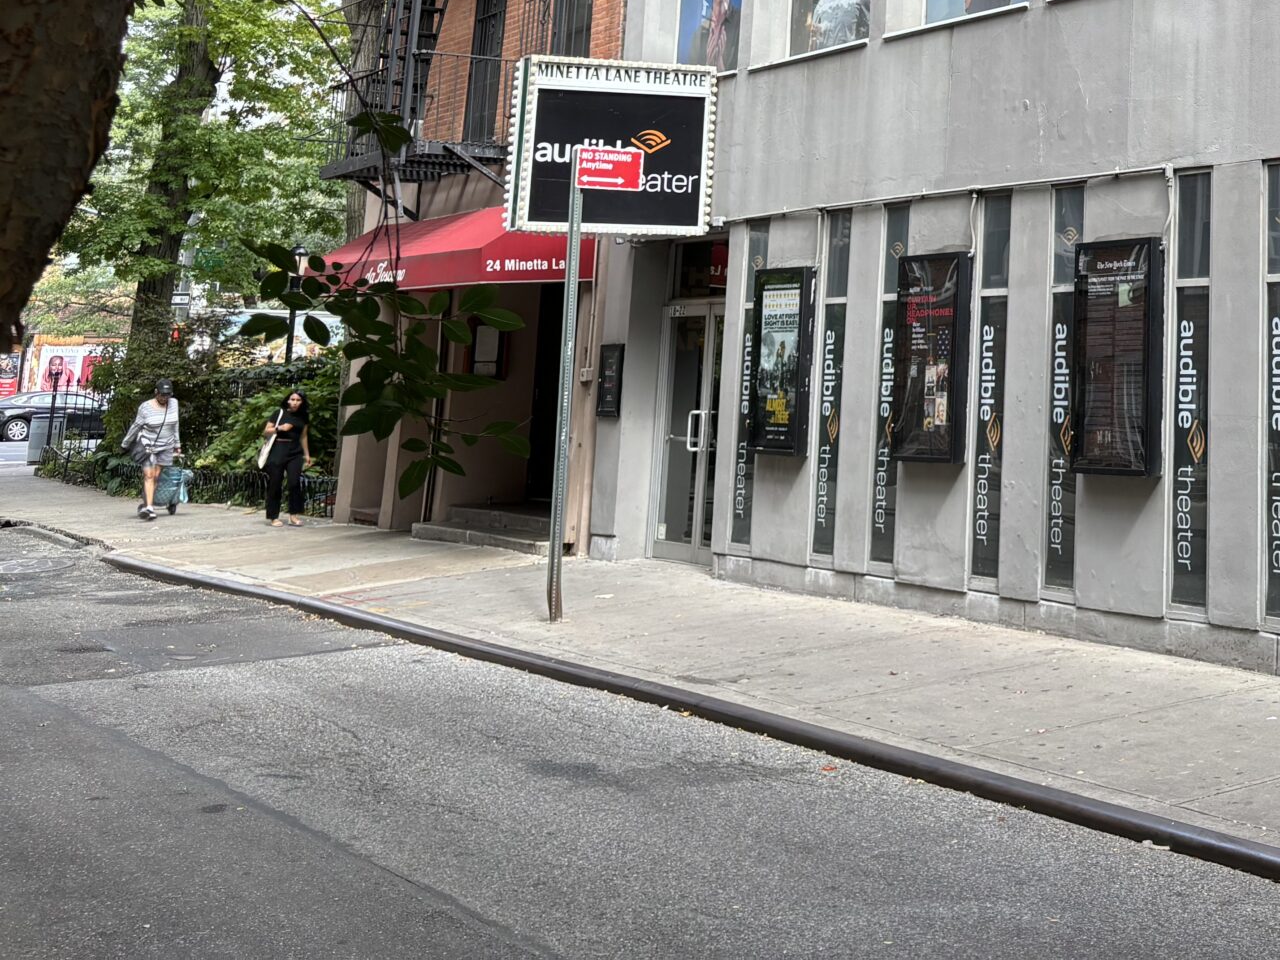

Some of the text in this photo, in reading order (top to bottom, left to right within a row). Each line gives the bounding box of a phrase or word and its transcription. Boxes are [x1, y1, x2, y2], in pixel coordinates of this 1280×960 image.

[538, 63, 706, 87] MINETTA LANE THEATRE
[582, 151, 632, 162] NO STANDING
[582, 160, 613, 170] Anytime
[486, 259, 501, 272] 24
[505, 258, 548, 271] Minetta
[816, 329, 835, 527] audible theater
[875, 327, 894, 533] audible theater
[975, 325, 995, 545] audible theater
[1050, 322, 1070, 555] audible theater
[1177, 320, 1197, 571] audible theater
